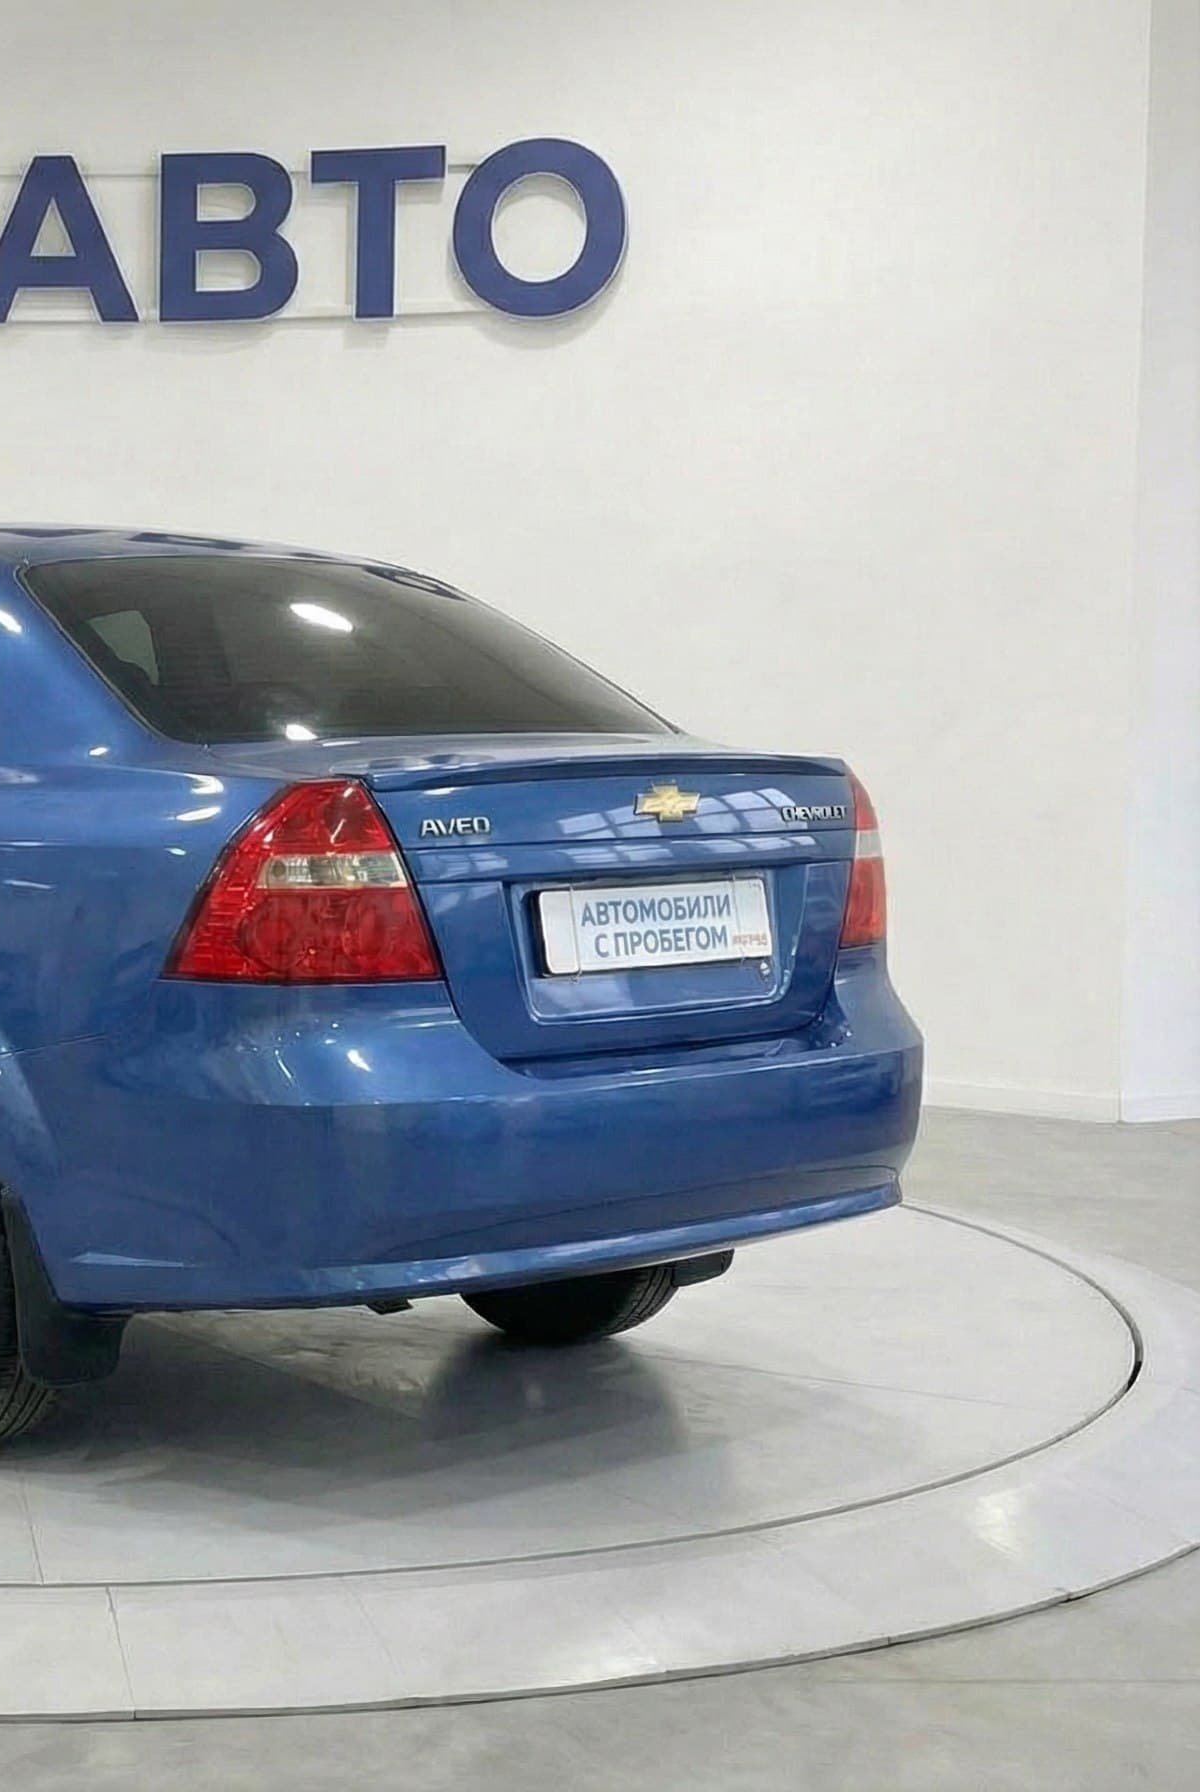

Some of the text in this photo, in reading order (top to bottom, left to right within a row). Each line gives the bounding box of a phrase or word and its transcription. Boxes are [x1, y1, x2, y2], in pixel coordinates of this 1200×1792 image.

[420, 815, 491, 838] AVEO
[781, 805, 846, 822] CHEVROLET
[580, 894, 732, 927] АВТОМОБИЛИ
[594, 933, 609, 958] С
[614, 925, 729, 957] ПРОБЕГОМ
